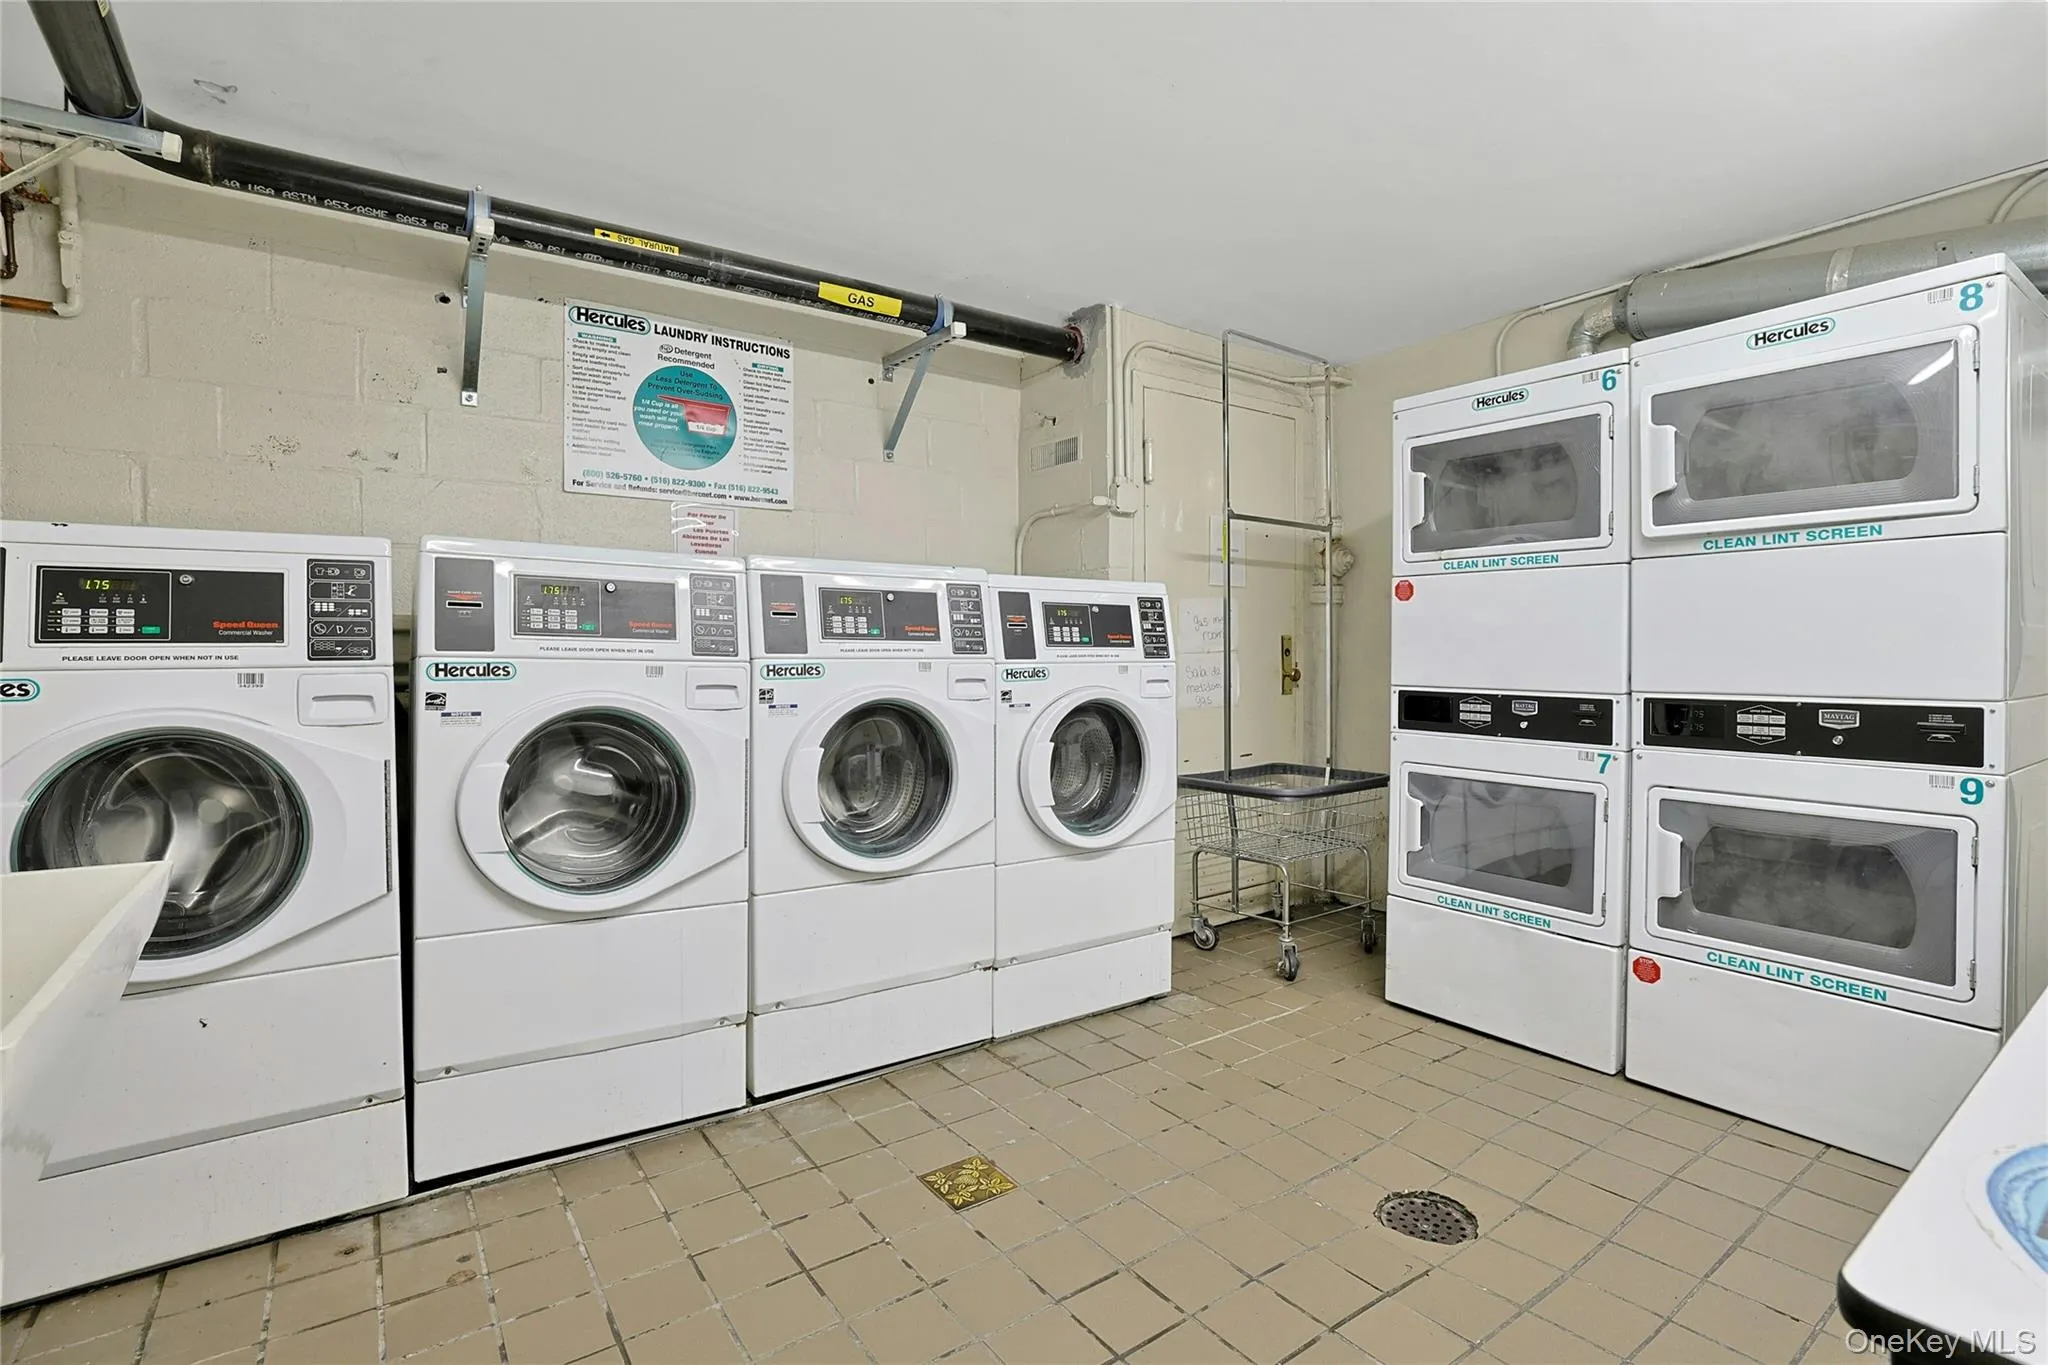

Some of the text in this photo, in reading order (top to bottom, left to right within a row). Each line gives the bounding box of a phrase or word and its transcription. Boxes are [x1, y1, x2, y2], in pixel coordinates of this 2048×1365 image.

[248, 184, 275, 196] USA
[282, 190, 317, 205] ASTM
[396, 213, 427, 227] SA53
[547, 244, 567, 256] PSI
[617, 234, 675, 254] NATURAL GAS
[847, 292, 875, 308] GAS
[1959, 283, 1984, 311] 8
[577, 307, 646, 332] Hercules
[654, 323, 791, 360] LAUNDRY INSTRUCTIONS
[1754, 319, 1829, 347] Hercules
[657, 353, 715, 370] Recommended
[674, 347, 712, 360] Detergent
[648, 382, 675, 393] Prevent
[656, 375, 672, 383] Less
[674, 378, 707, 389] Detergent
[1602, 369, 1617, 391] 6
[1476, 391, 1525, 409] Hercules
[1703, 524, 1883, 551] CLEAN LINT SCREEN
[1443, 553, 1560, 571] CLEAN LINT SCREEN
[213, 621, 279, 630] Speed Queen
[434, 663, 511, 677] Hercules
[766, 664, 821, 677] Hercules
[1006, 669, 1047, 680] Hercules
[1823, 712, 1855, 721] MAYTAG
[1597, 753, 1612, 774] 7
[1959, 777, 1984, 805] 9
[1437, 895, 1551, 929] CLEAN LINT SCREEN
[1706, 951, 1888, 1002] CLEAN LINT SCREEN
